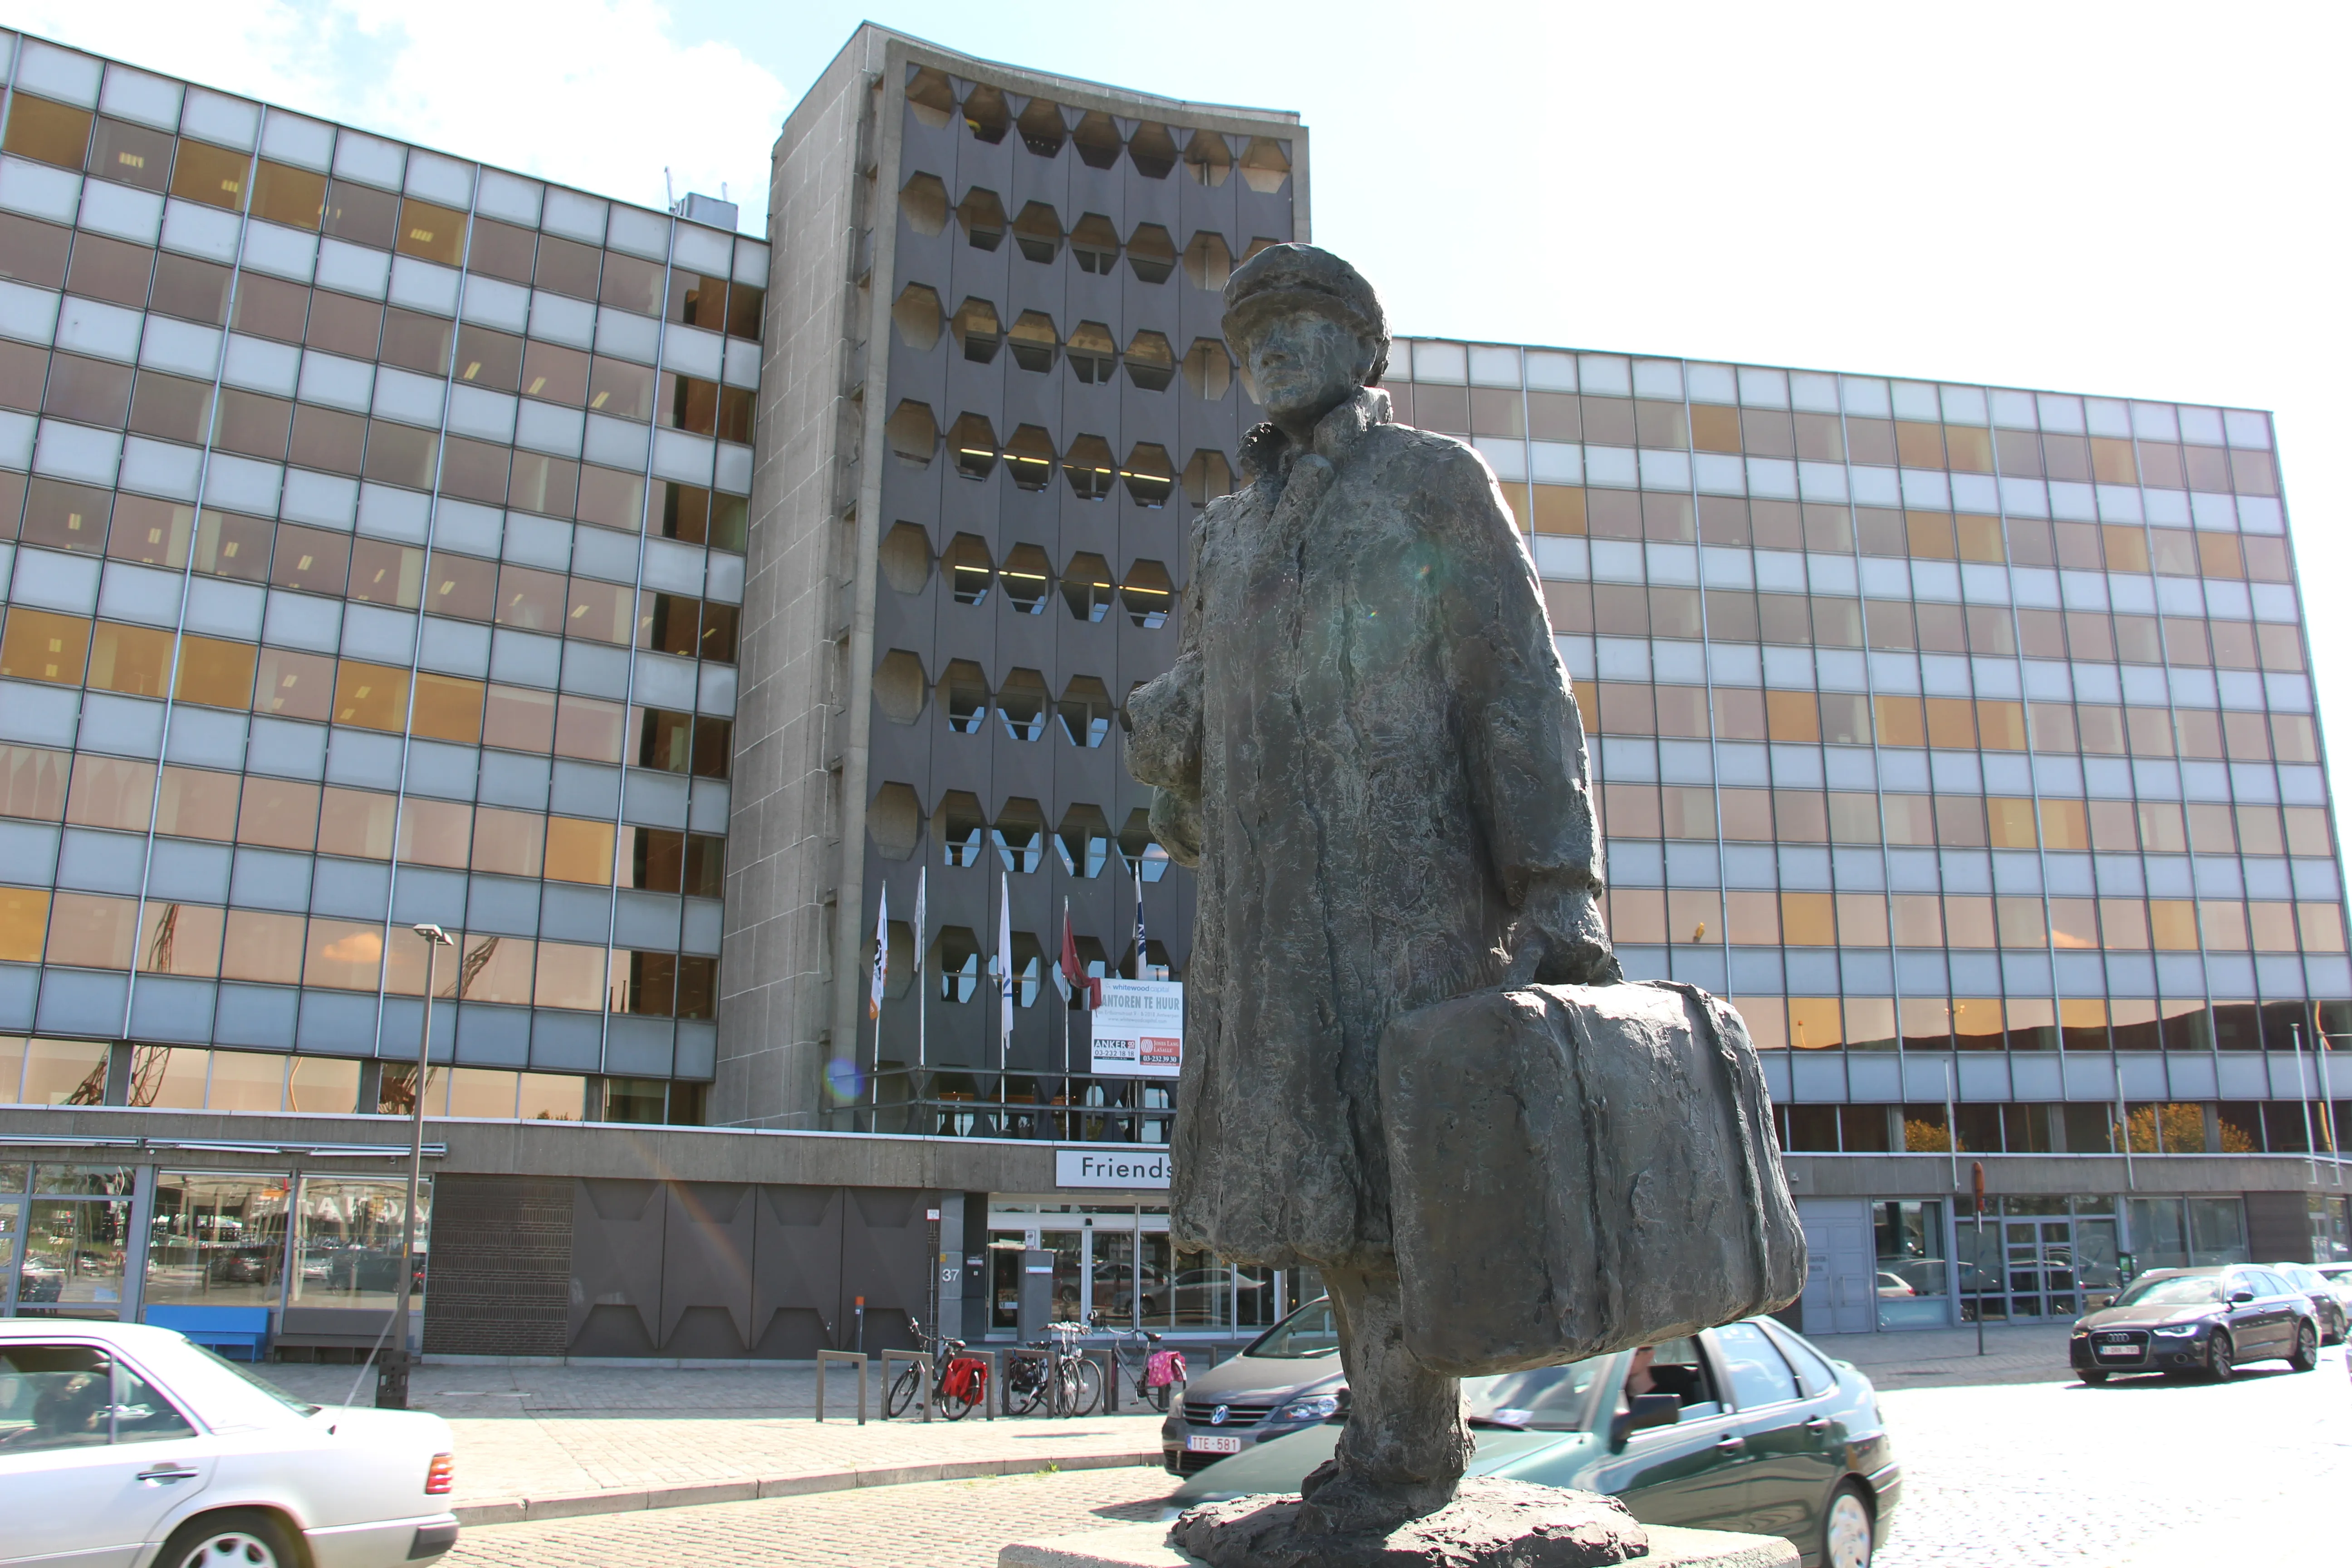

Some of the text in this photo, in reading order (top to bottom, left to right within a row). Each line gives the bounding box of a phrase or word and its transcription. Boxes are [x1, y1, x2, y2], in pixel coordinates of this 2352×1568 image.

[1101, 994, 1180, 1010] ANTOREN TE HUUR
[1095, 1040, 1126, 1049] ANKER
[942, 1269, 960, 1282] 37
[1192, 1437, 1236, 1451] TTE-581
